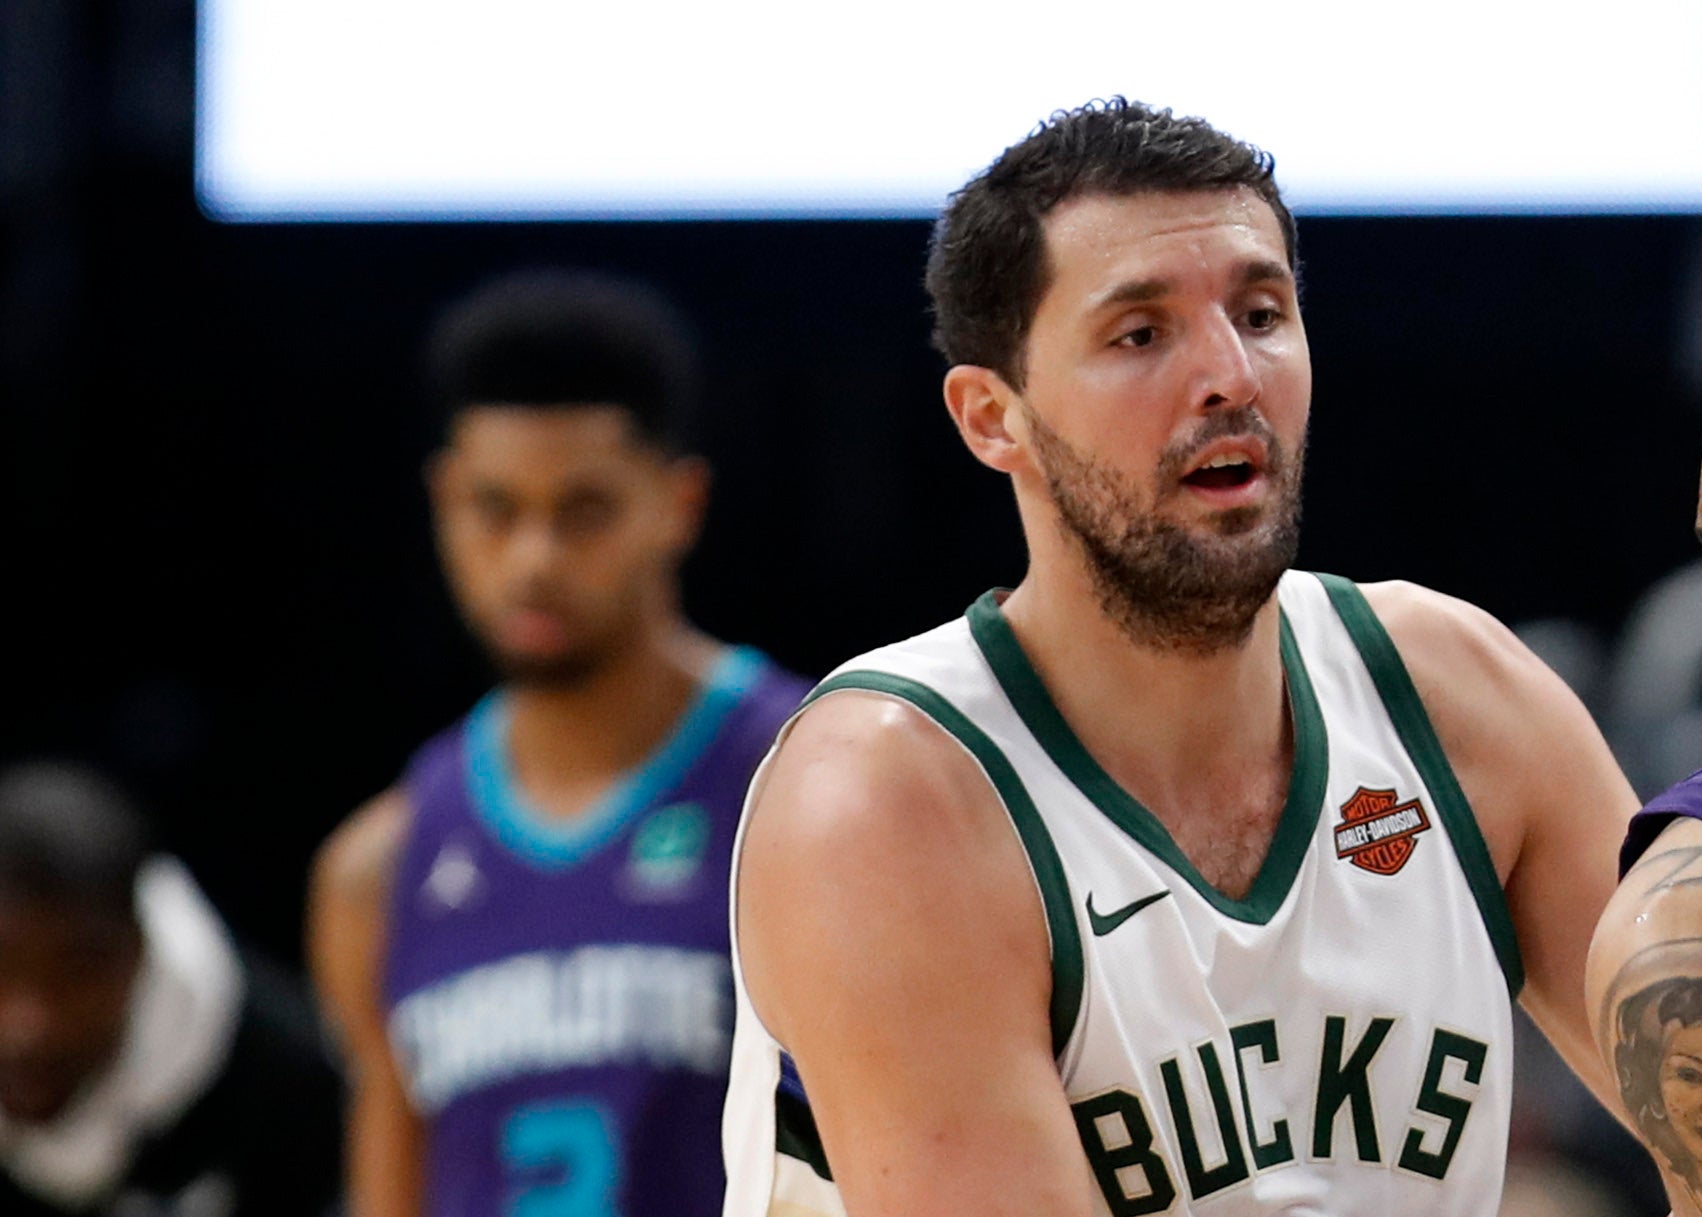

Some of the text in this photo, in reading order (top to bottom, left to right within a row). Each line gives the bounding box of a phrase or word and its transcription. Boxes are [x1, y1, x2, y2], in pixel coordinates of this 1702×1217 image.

[1346, 795, 1392, 820] MOTOR
[1337, 806, 1422, 853] HARLEY-DAVIDSON
[1360, 838, 1408, 869] CYCLES
